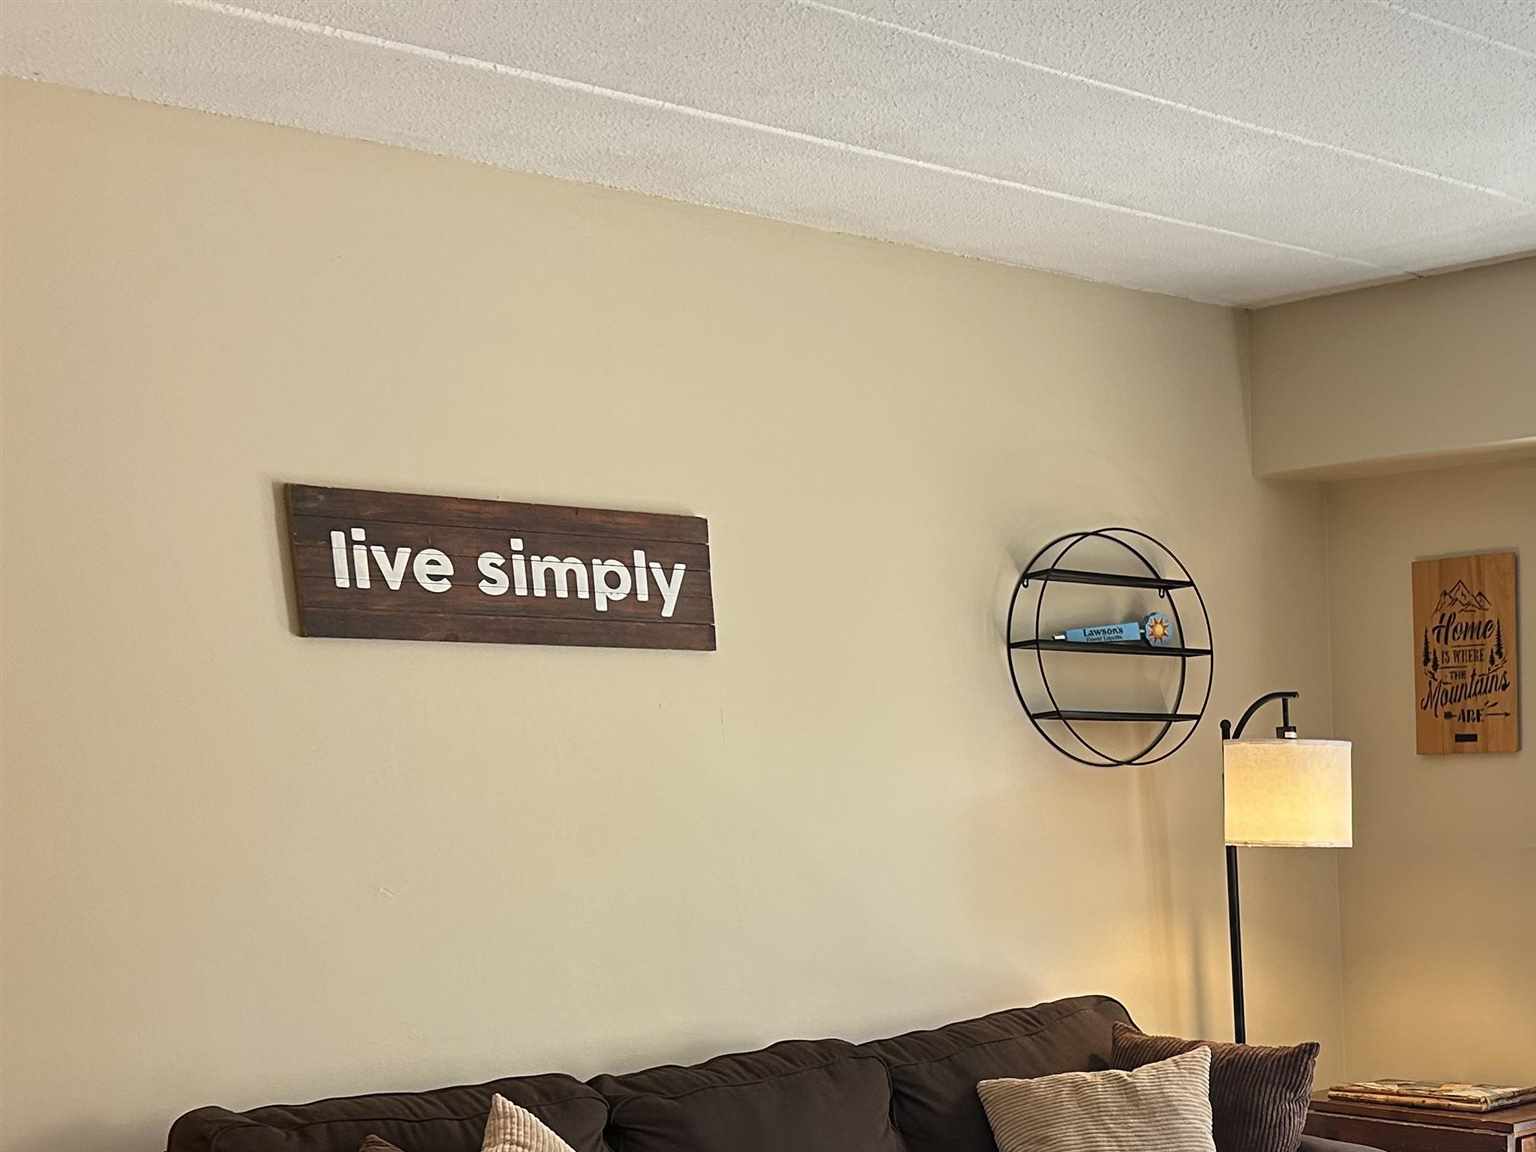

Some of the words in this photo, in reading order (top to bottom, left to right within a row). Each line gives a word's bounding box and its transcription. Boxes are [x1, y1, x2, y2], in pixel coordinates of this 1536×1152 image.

[330, 527, 455, 594] live
[477, 538, 687, 618] simply
[1431, 611, 1495, 645] Home
[1441, 650, 1450, 664] IS
[1453, 649, 1484, 664] WHERE
[1421, 668, 1510, 718] Mountains
[1457, 708, 1485, 723] ARE
